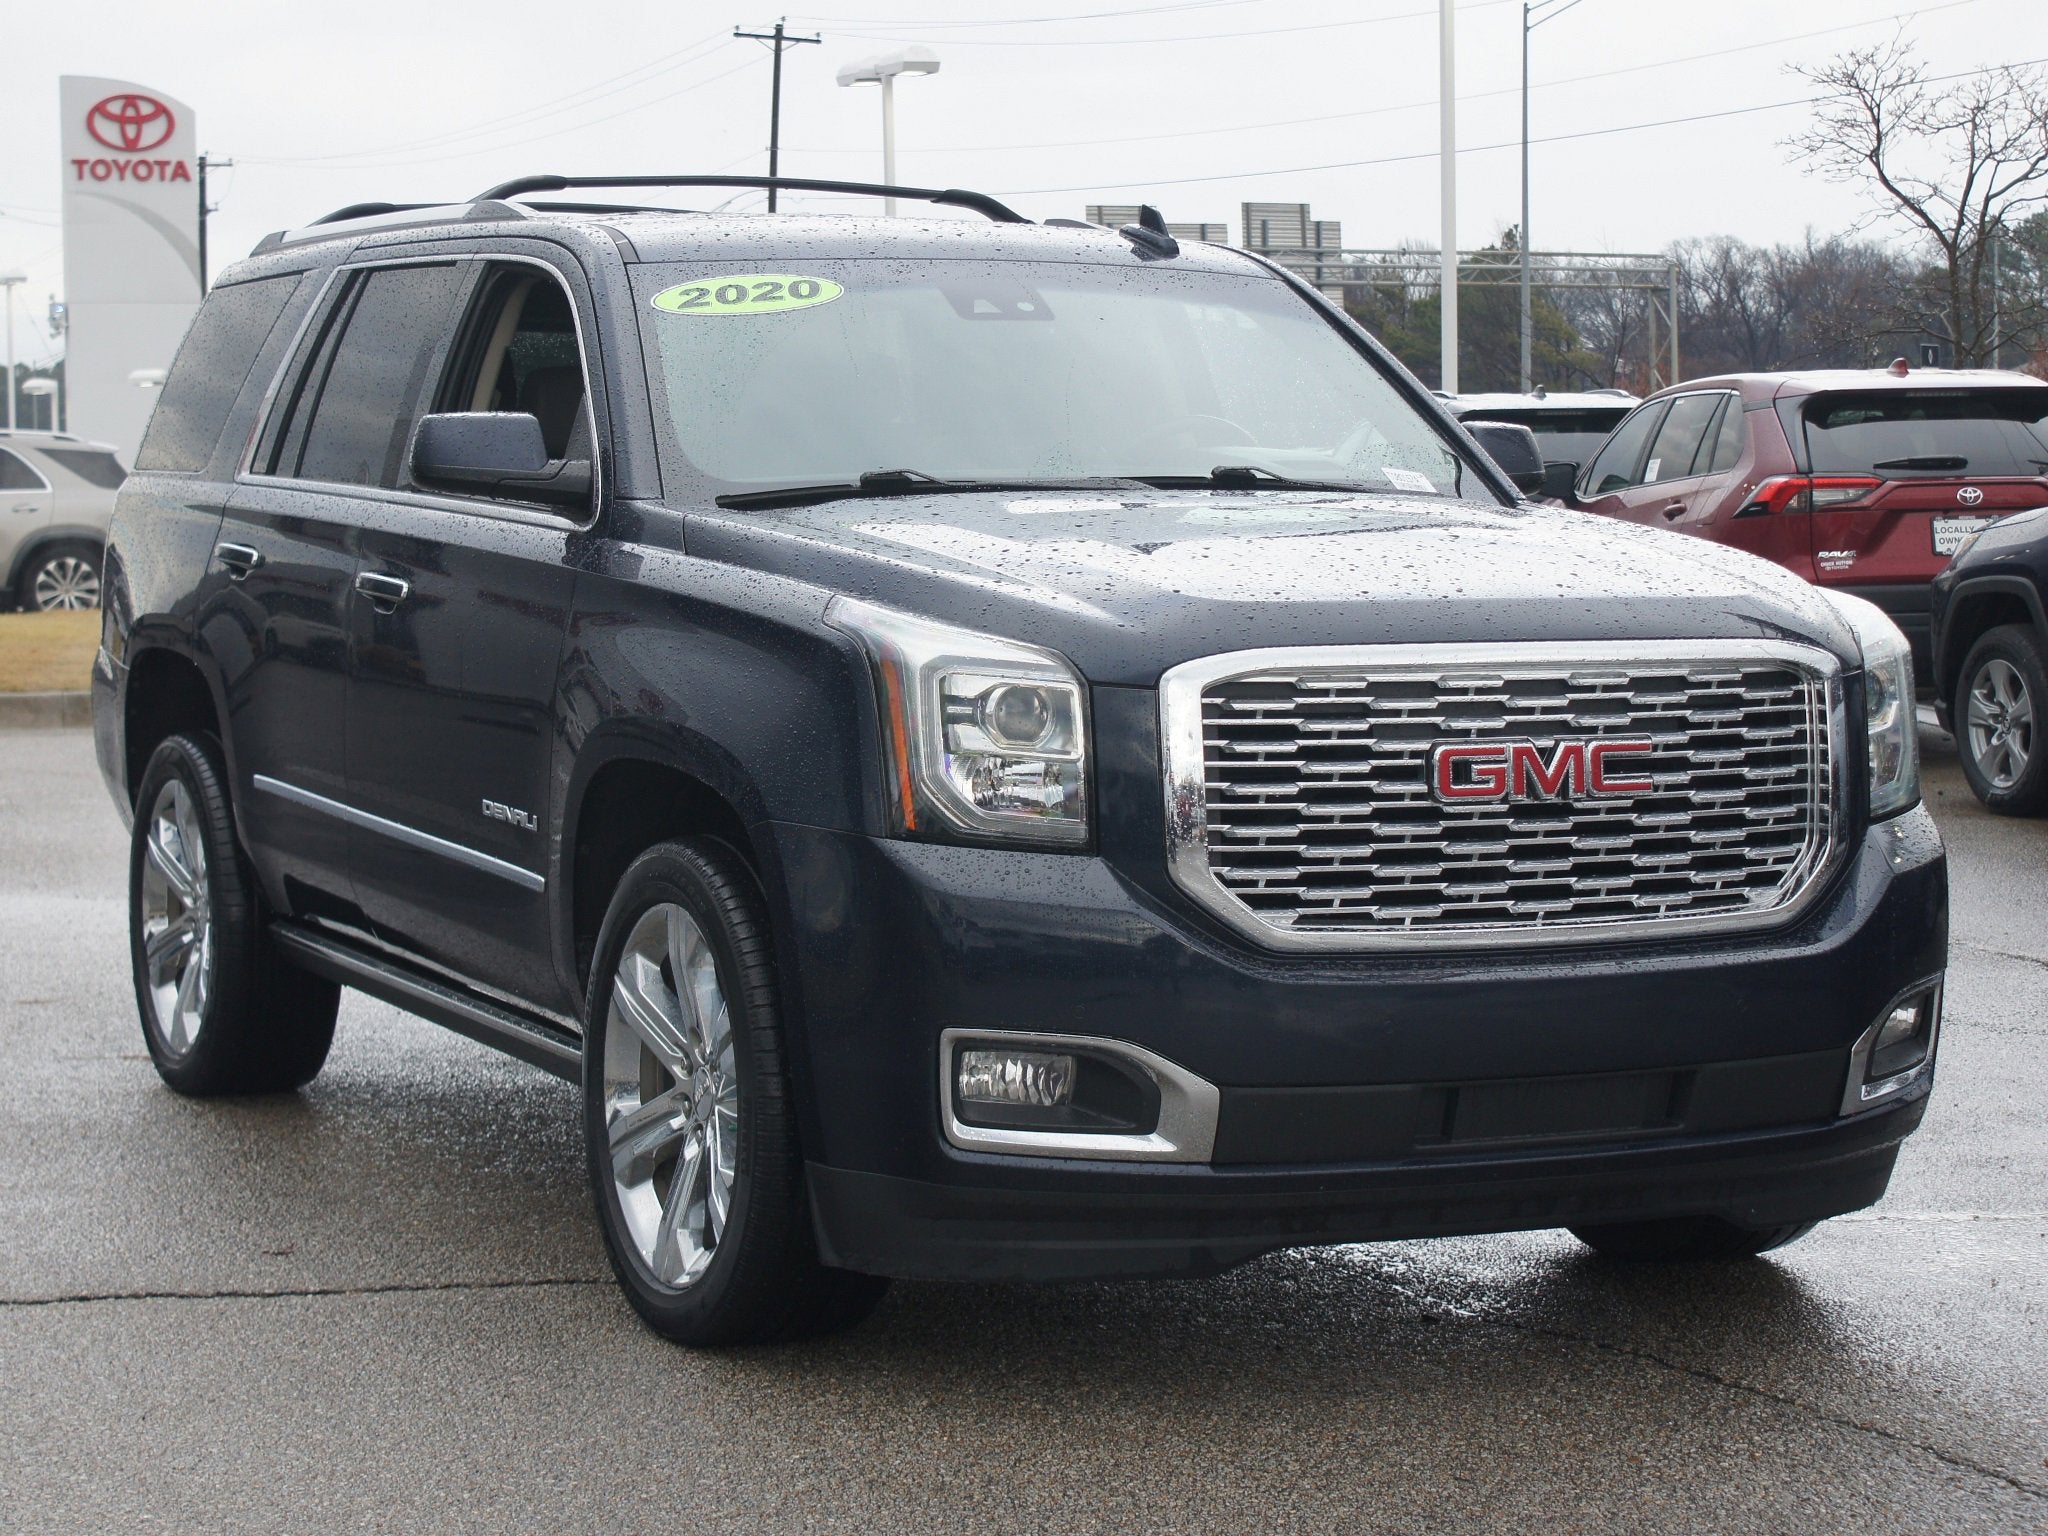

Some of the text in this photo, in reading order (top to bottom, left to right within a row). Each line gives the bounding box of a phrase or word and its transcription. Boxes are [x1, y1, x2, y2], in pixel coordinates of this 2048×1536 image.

[72, 159, 191, 181] TOYOTA
[677, 279, 822, 309] 2020
[1935, 526, 1974, 534] LOCALLY
[1939, 537, 1962, 545] OWN
[1818, 550, 1856, 558] RAV4
[1434, 740, 1653, 802] GMC
[482, 799, 537, 832] DENALI
